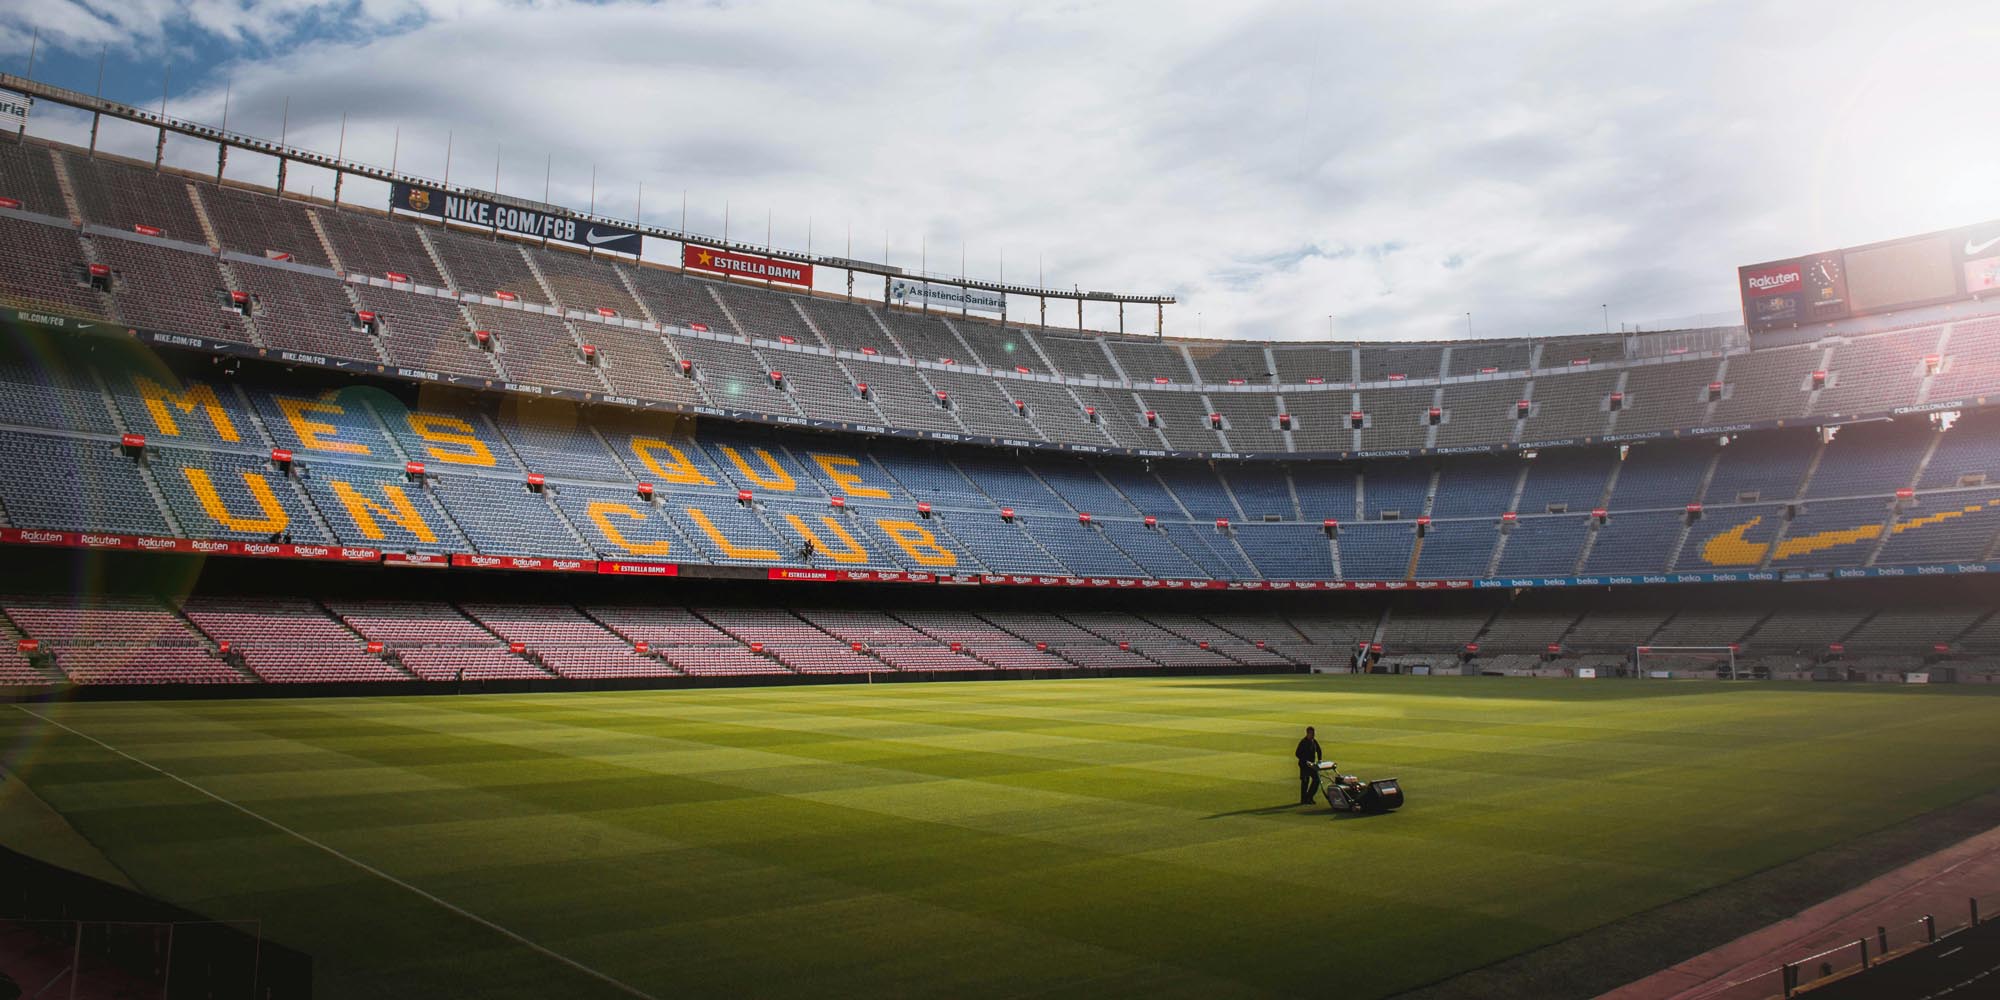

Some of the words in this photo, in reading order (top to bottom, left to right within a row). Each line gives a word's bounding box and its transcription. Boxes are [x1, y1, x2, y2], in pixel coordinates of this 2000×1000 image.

[445, 196, 576, 241] NIKE.COM/FCB
[714, 256, 766, 275] ESTRELLA
[768, 265, 801, 280] DAMM
[1749, 272, 1799, 288] Rakuten
[909, 286, 964, 302] Assistència
[154, 333, 202, 348] NIKE.COM/FCB
[282, 352, 325, 365] NIKE.COM/FCB
[398, 368, 438, 381] NIKE.COM/FCB
[505, 383, 542, 394] NIKE.COM/FCB
[631, 437, 892, 499] QUE
[184, 467, 439, 543] UN
[586, 502, 958, 566] CLUB
[21, 531, 62, 542] Rakuten
[81, 535, 120, 545] Rakuten
[138, 538, 176, 548] Rakuten
[192, 541, 228, 550] Rakuten
[244, 544, 280, 553] Rakuten
[294, 546, 328, 556] Rakuten
[342, 549, 374, 558] Rakuten
[472, 556, 500, 565] Rakuten
[512, 558, 541, 567] Rakuten
[552, 560, 580, 568] Rakuten
[1878, 568, 1904, 576] beko
[1918, 566, 1944, 574] beko
[1958, 564, 1986, 572] beko
